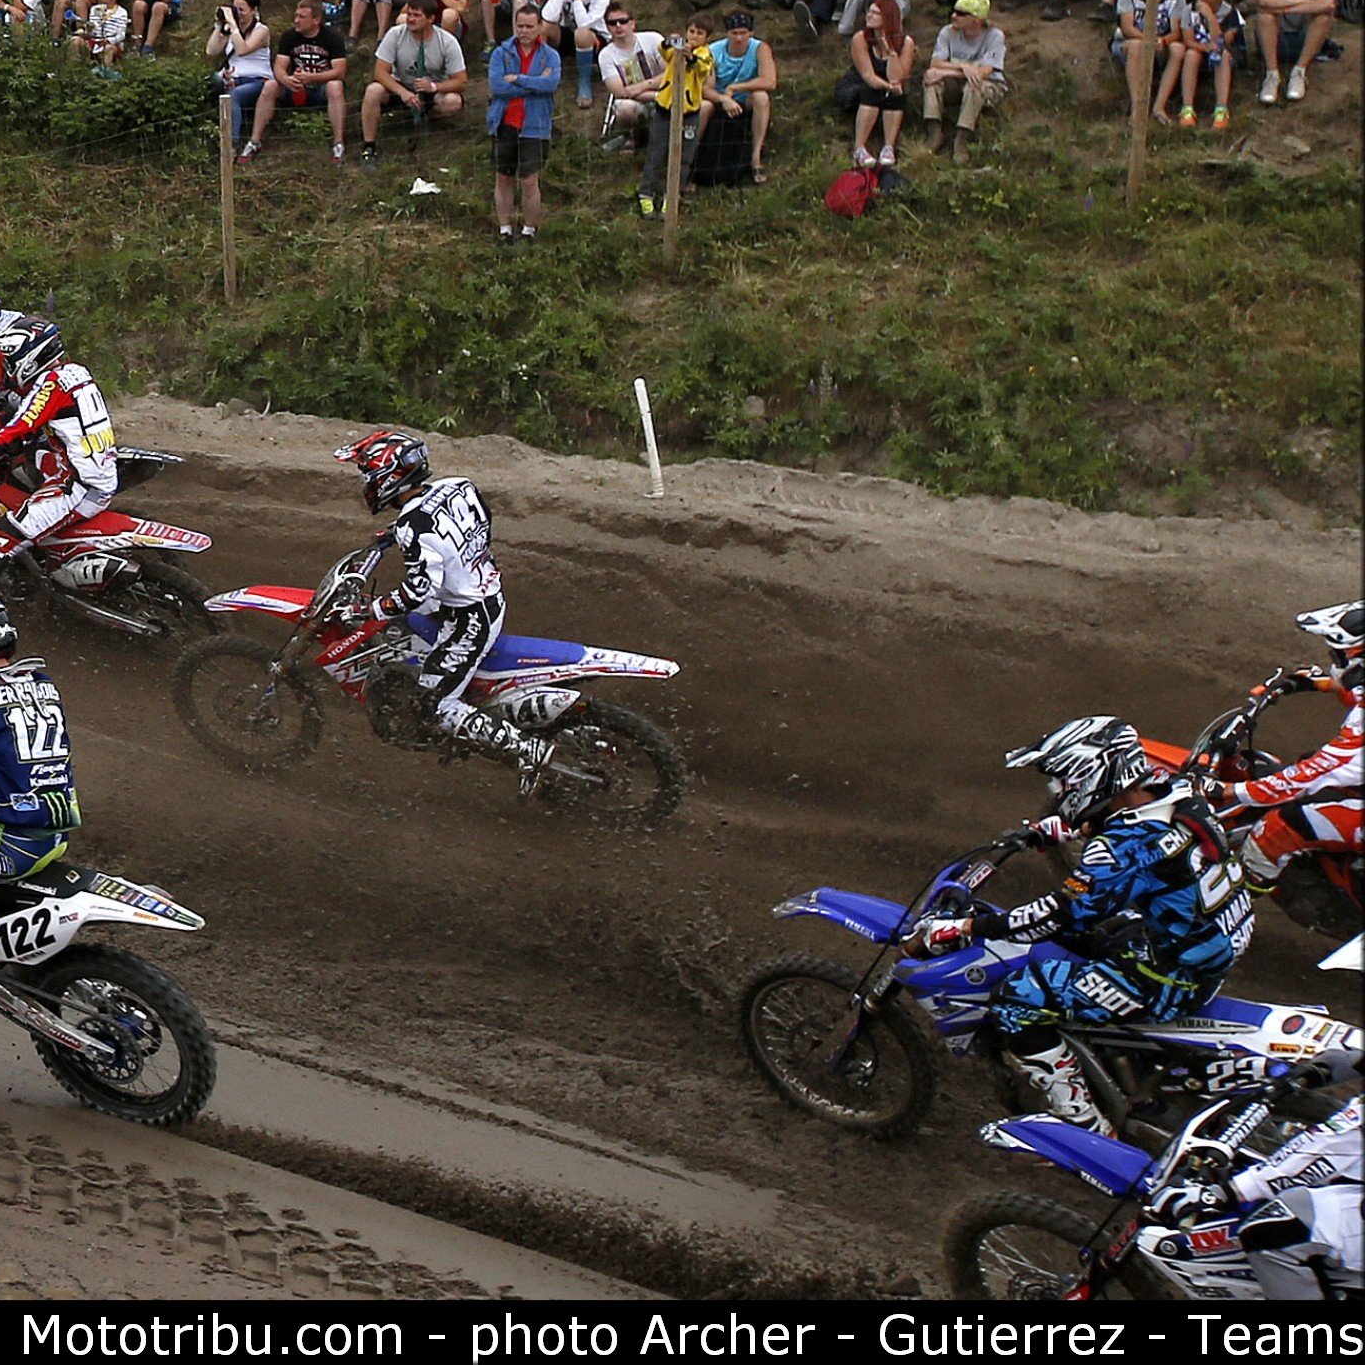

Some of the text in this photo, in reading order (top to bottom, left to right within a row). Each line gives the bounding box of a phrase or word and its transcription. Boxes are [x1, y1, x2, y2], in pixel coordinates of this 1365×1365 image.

[431, 482, 489, 553] 141
[326, 630, 366, 659] HONDA
[7, 704, 69, 761] 122
[1074, 971, 1146, 1017] SHOT
[1175, 1020, 1216, 1030] YAMAHA
[1206, 1055, 1268, 1092] 23
